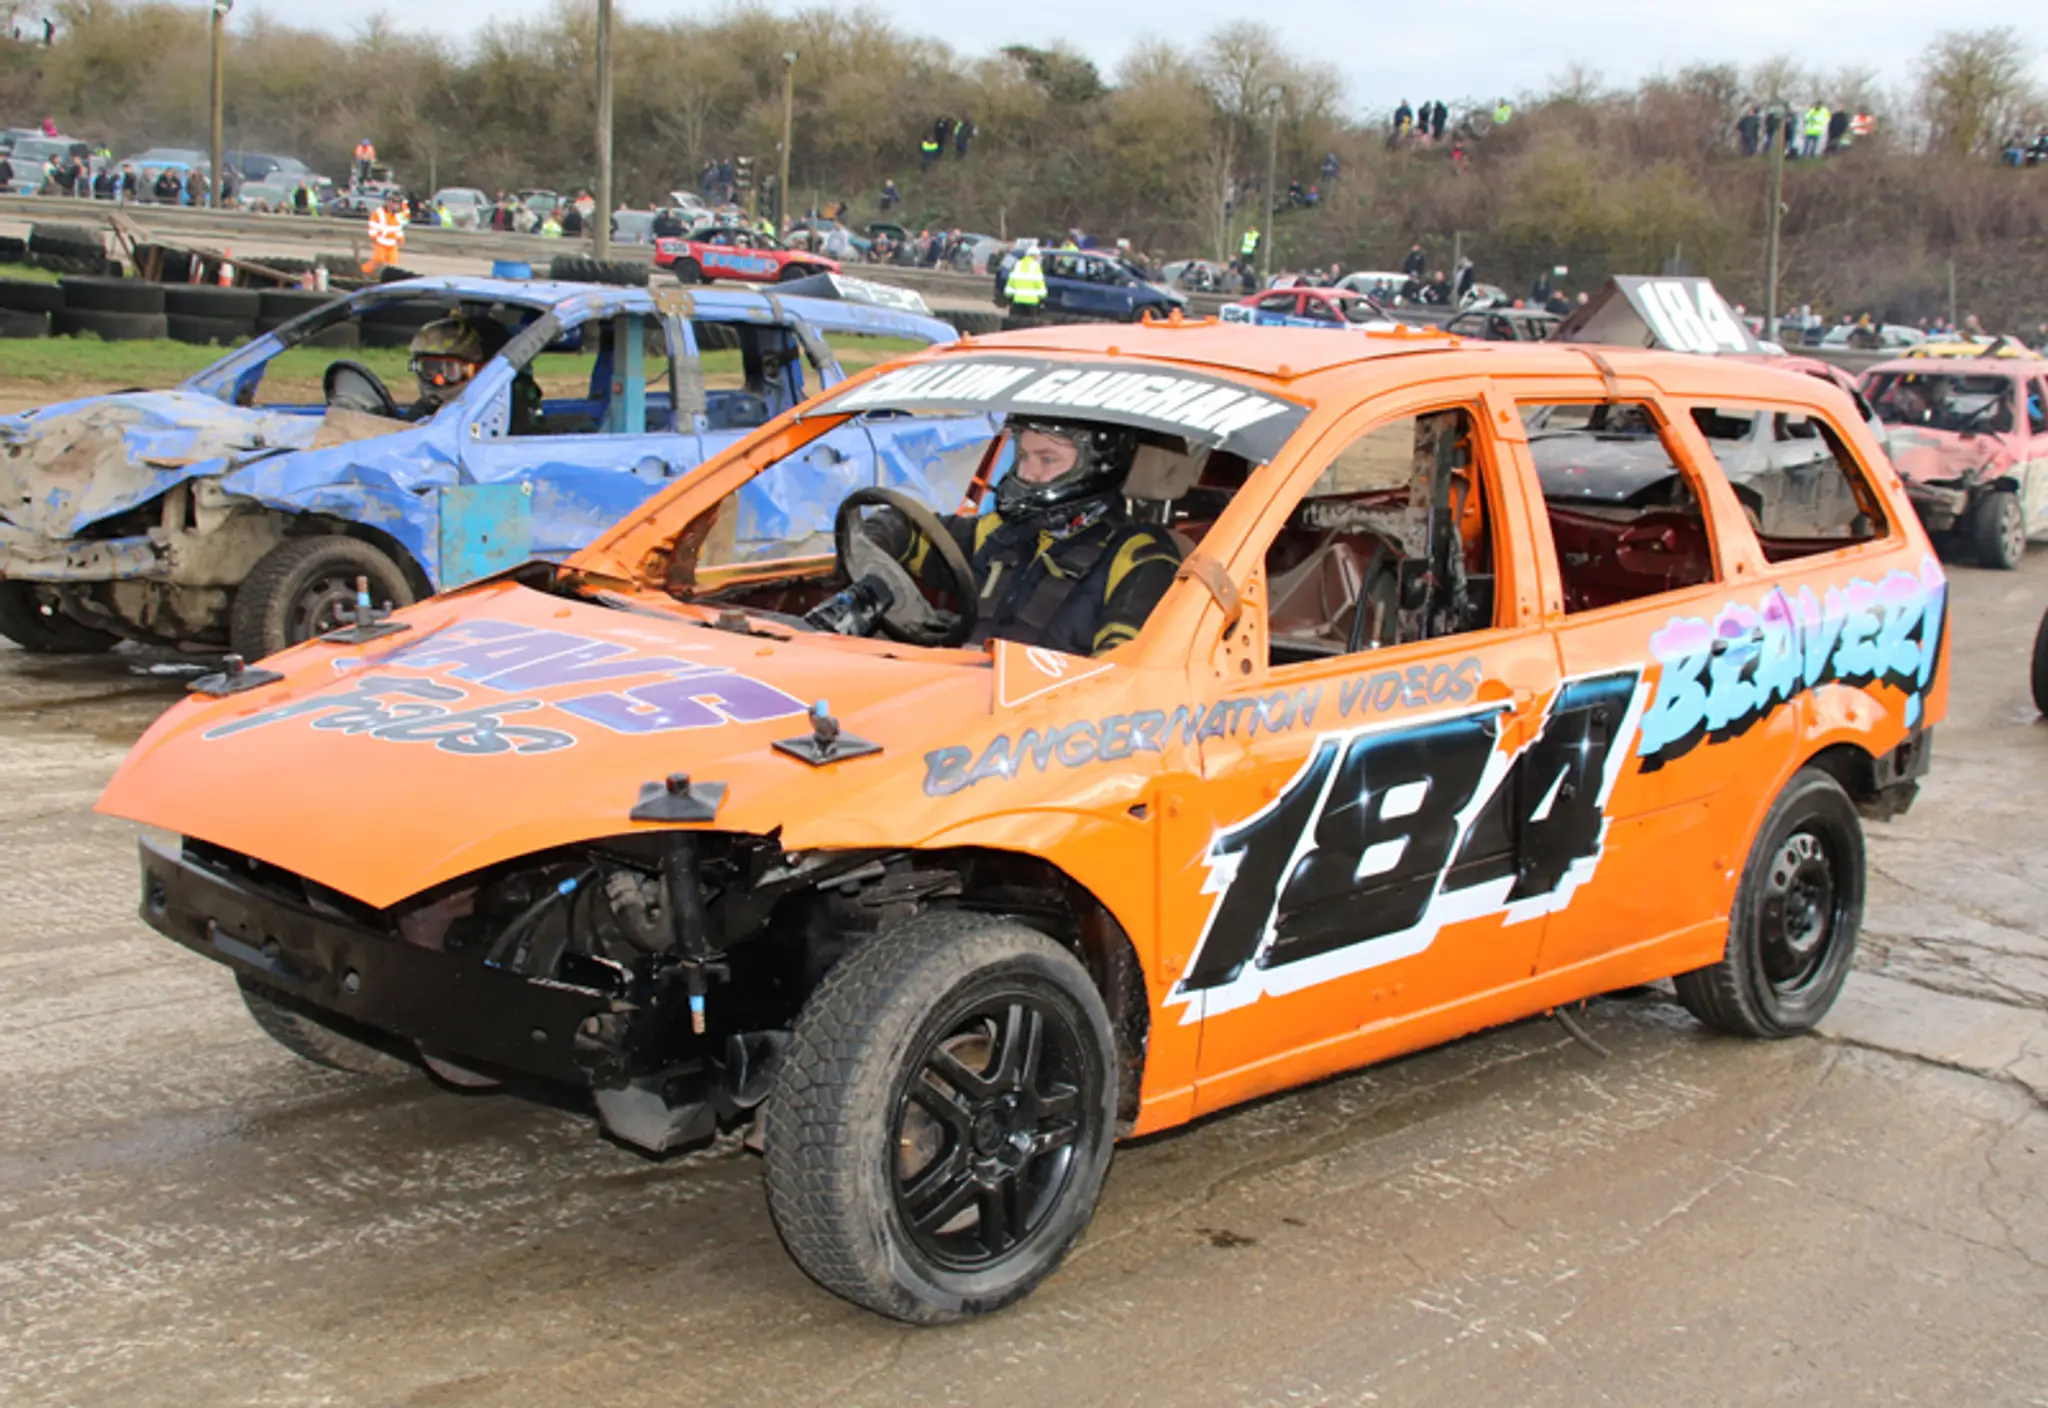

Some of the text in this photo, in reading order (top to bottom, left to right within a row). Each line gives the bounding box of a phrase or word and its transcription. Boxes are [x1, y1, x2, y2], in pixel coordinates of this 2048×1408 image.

[1637, 281, 1748, 353] 184
[1011, 368, 1289, 447] GAUGHAN
[923, 657, 1482, 796] BANGERNATION VIDEOS
[1636, 552, 1948, 773] BEAVER!
[1163, 662, 1652, 1025] 184
